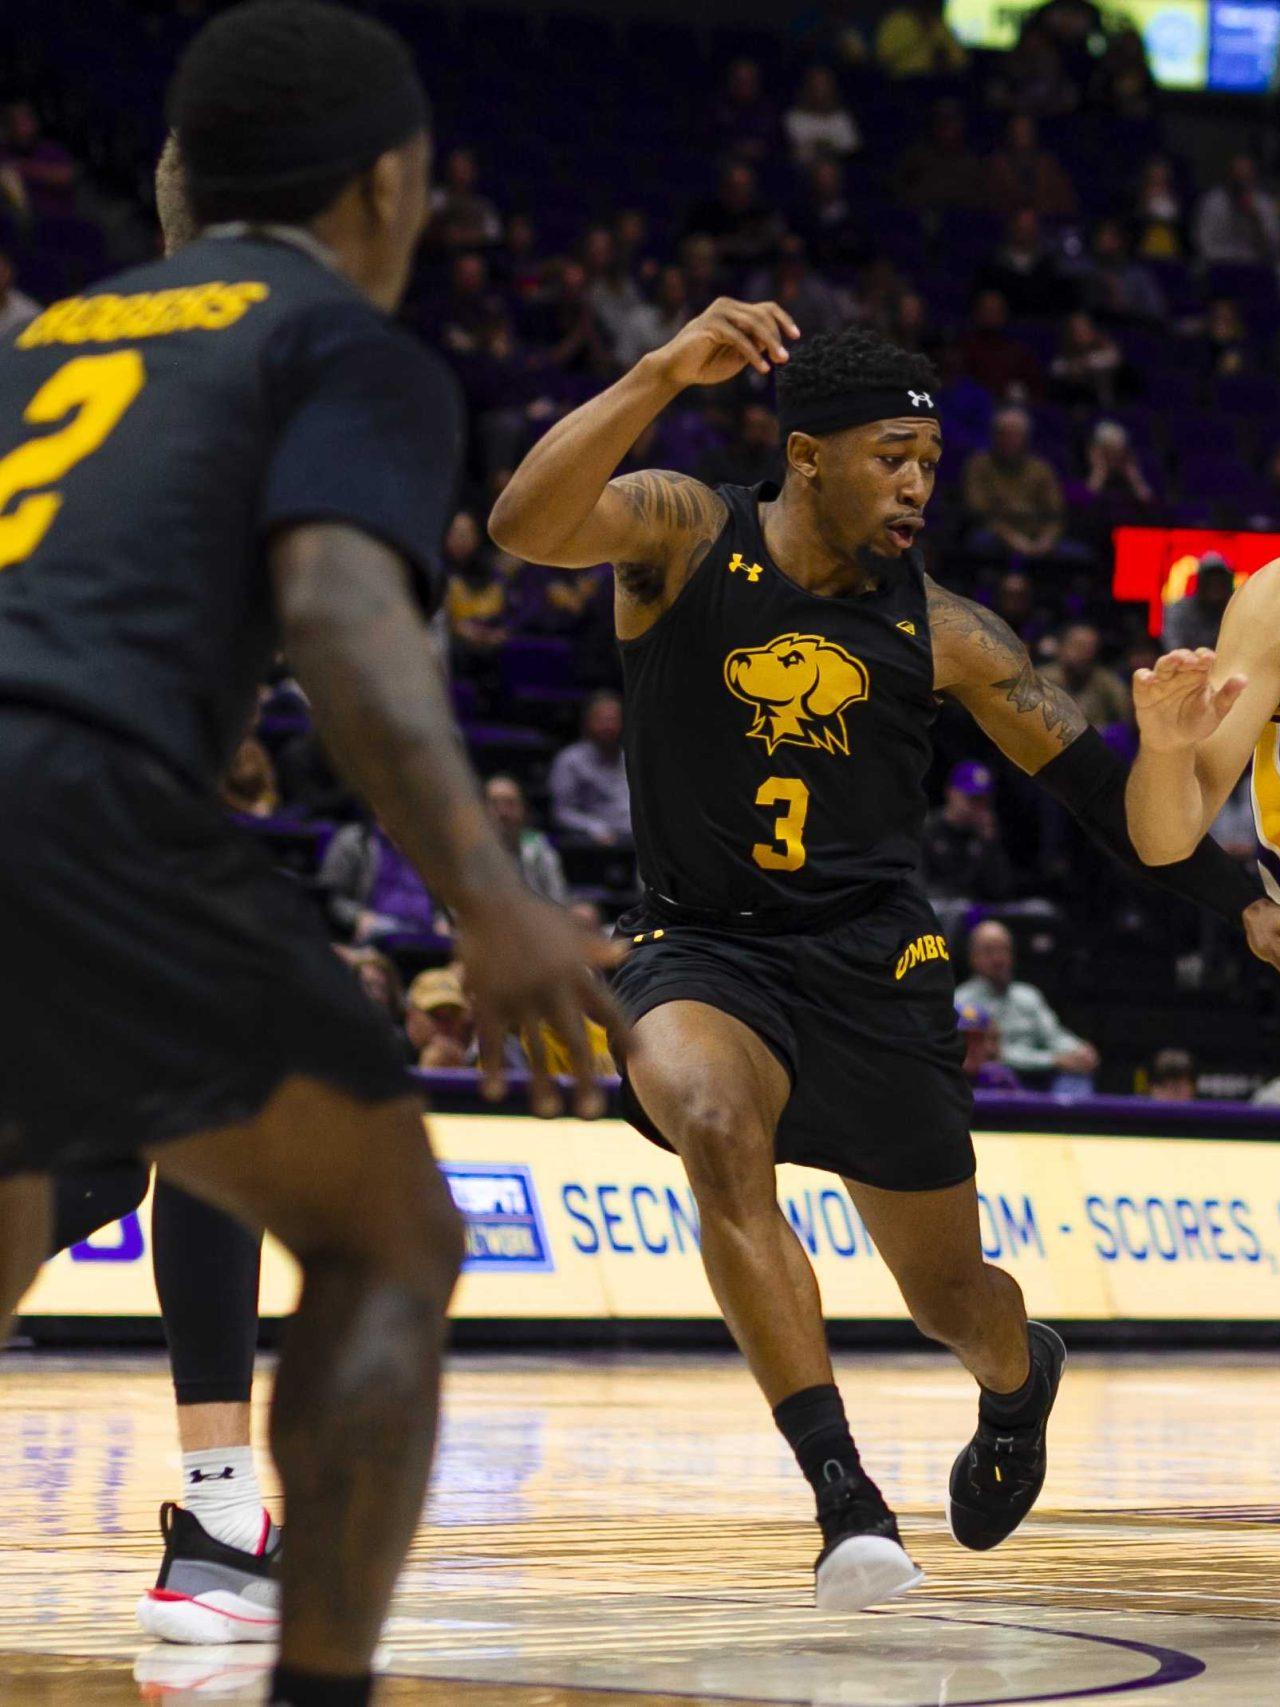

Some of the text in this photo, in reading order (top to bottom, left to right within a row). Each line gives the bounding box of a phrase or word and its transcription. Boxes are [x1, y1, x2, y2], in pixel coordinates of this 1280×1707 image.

[0, 349, 146, 571] 2
[752, 776, 810, 872] 3
[895, 934, 949, 980] UMBC
[1086, 1196, 1279, 1275] SCORES,
